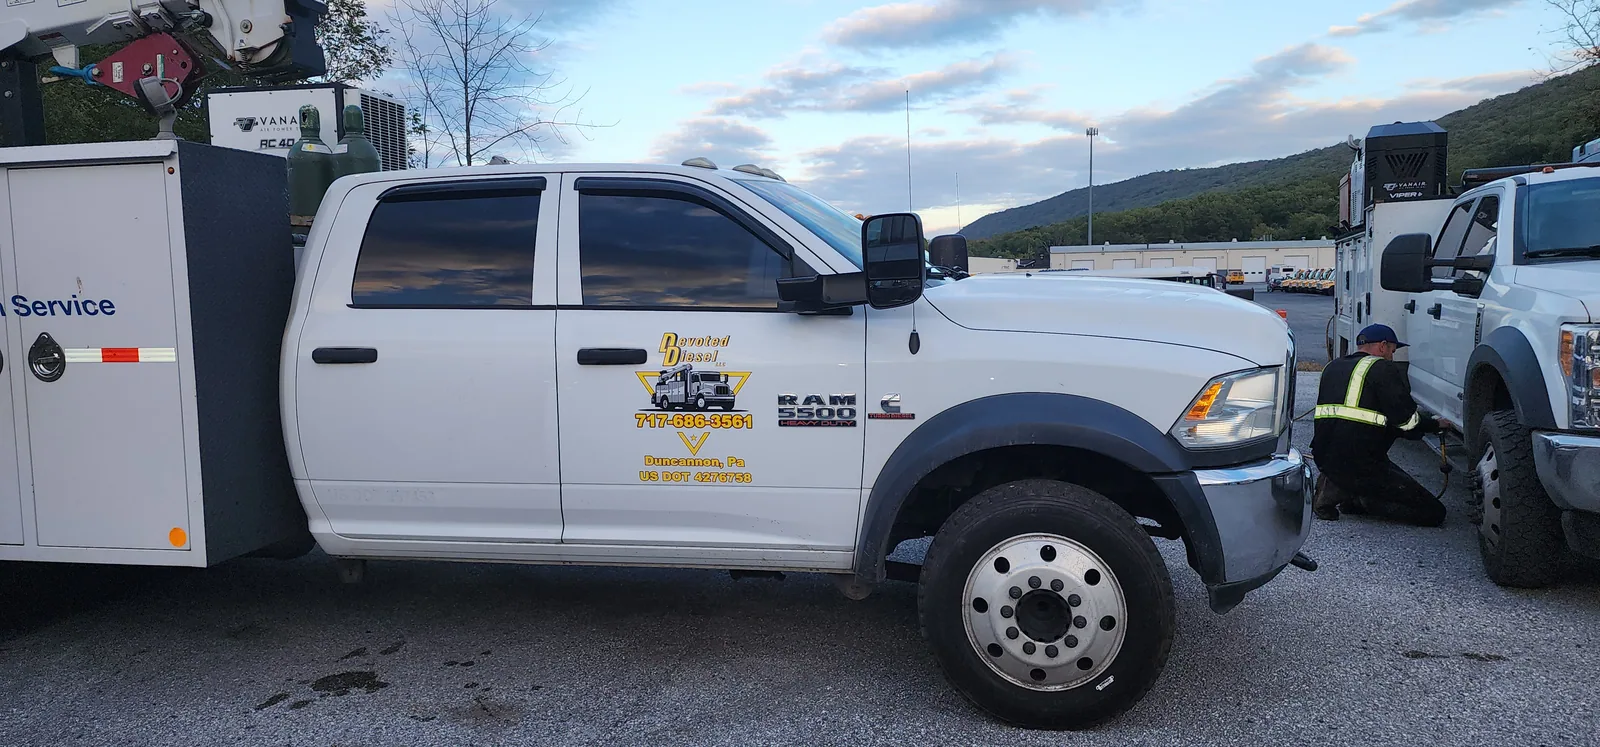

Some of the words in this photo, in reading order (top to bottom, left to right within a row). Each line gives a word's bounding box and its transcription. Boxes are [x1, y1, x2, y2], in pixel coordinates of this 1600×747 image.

[260, 116, 298, 126] VANA
[11, 294, 116, 317] Service
[659, 332, 731, 353] Devoted
[663, 346, 718, 367] Diesel
[778, 393, 857, 406] RAM
[778, 407, 857, 420] 5500
[635, 413, 753, 429] 717-686-3561
[644, 455, 724, 469] Duncannon,
[727, 456, 746, 467] Pa
[639, 471, 659, 481] US
[661, 471, 691, 482] DOT
[694, 472, 753, 483] 4276758
